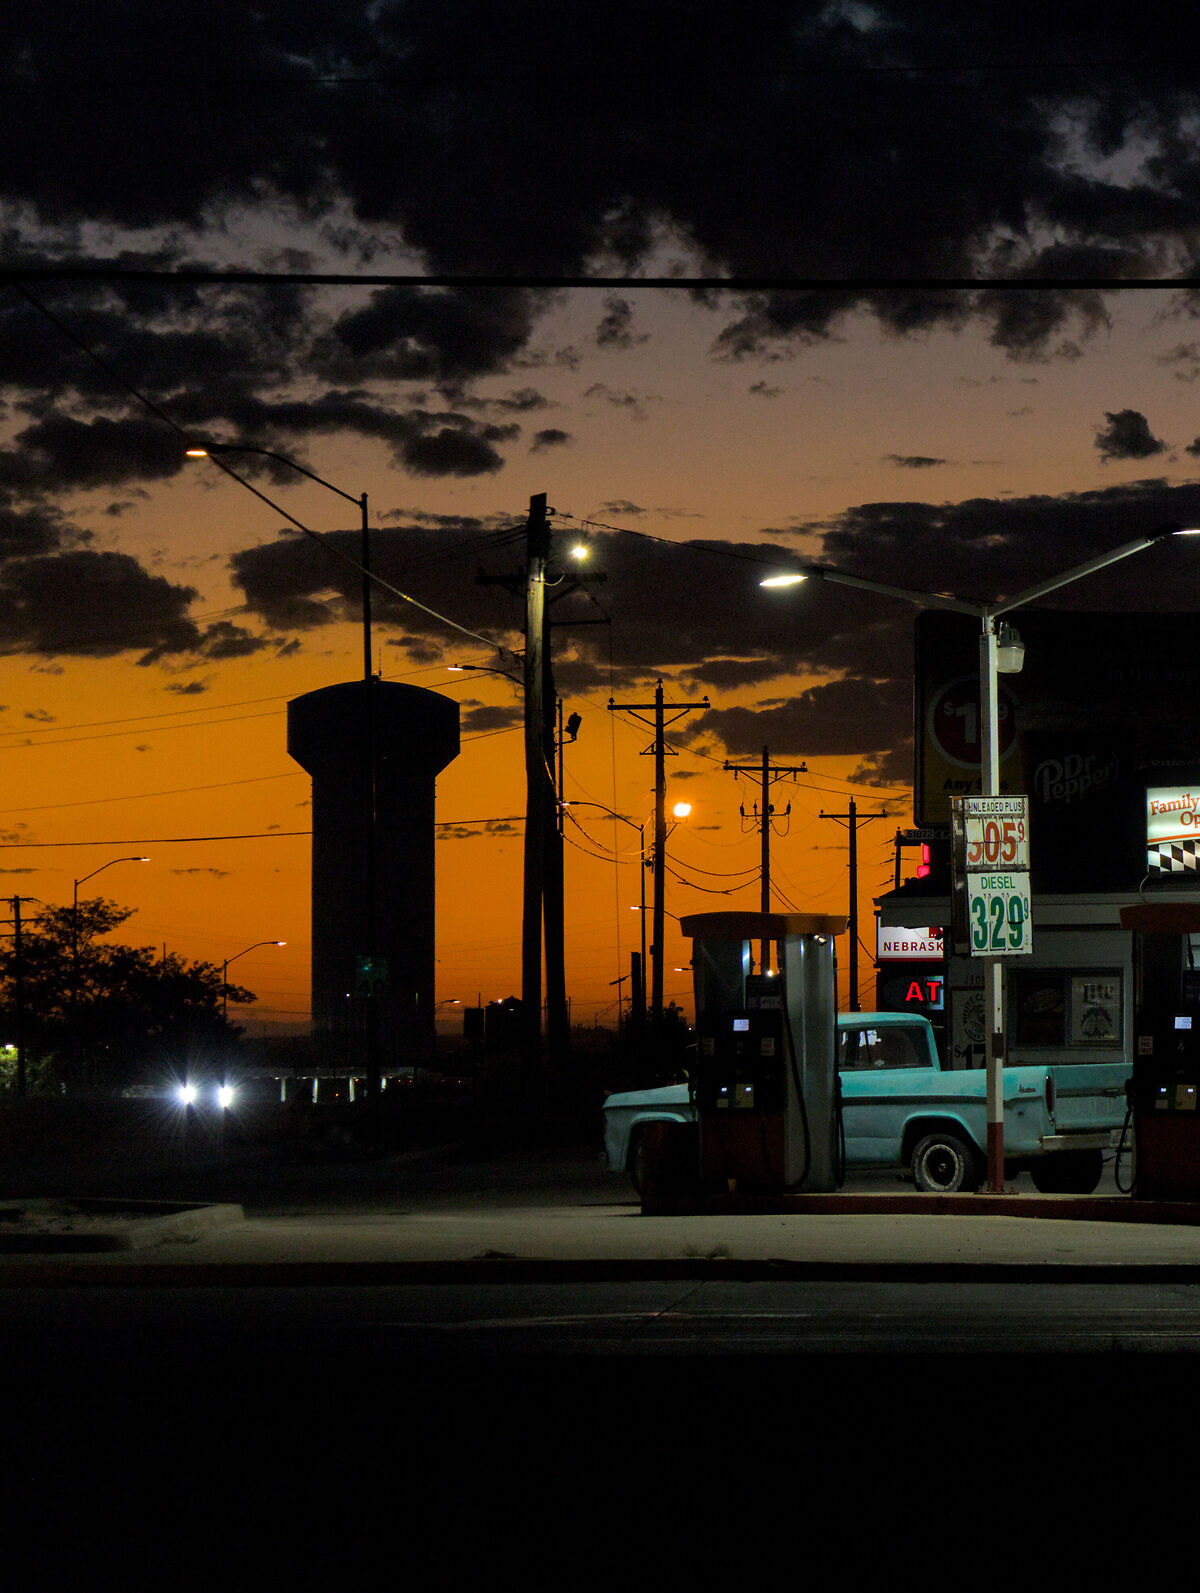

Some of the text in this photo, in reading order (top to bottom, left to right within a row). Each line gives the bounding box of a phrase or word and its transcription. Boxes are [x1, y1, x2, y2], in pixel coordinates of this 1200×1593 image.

[943, 778, 973, 793] Any
[968, 801, 1022, 813] UNLEADED PLUS
[1150, 793, 1200, 816] Family
[980, 876, 1016, 889] DIESEL
[883, 941, 944, 951] NEBRASK
[905, 981, 941, 1002] AT
